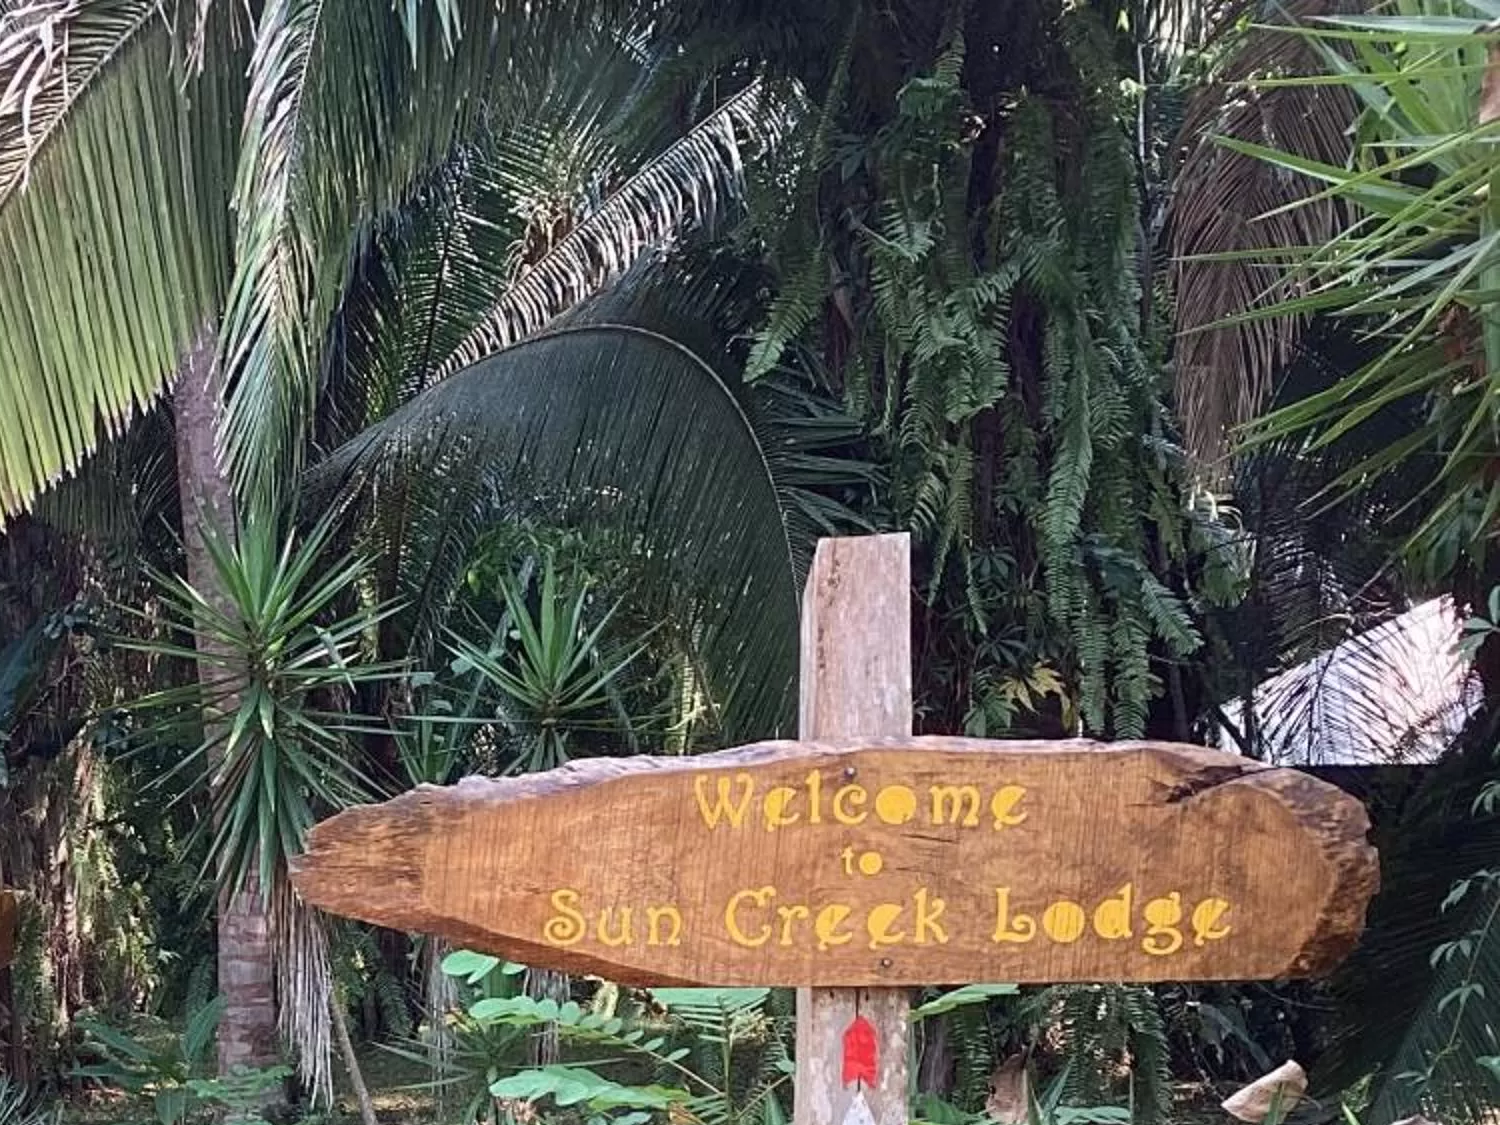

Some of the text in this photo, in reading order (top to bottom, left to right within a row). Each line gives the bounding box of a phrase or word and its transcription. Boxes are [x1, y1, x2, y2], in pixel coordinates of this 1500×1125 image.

[694, 769, 1029, 832] Welcome
[841, 846, 884, 876] to
[543, 882, 1233, 956] Sun Creek Lodge
